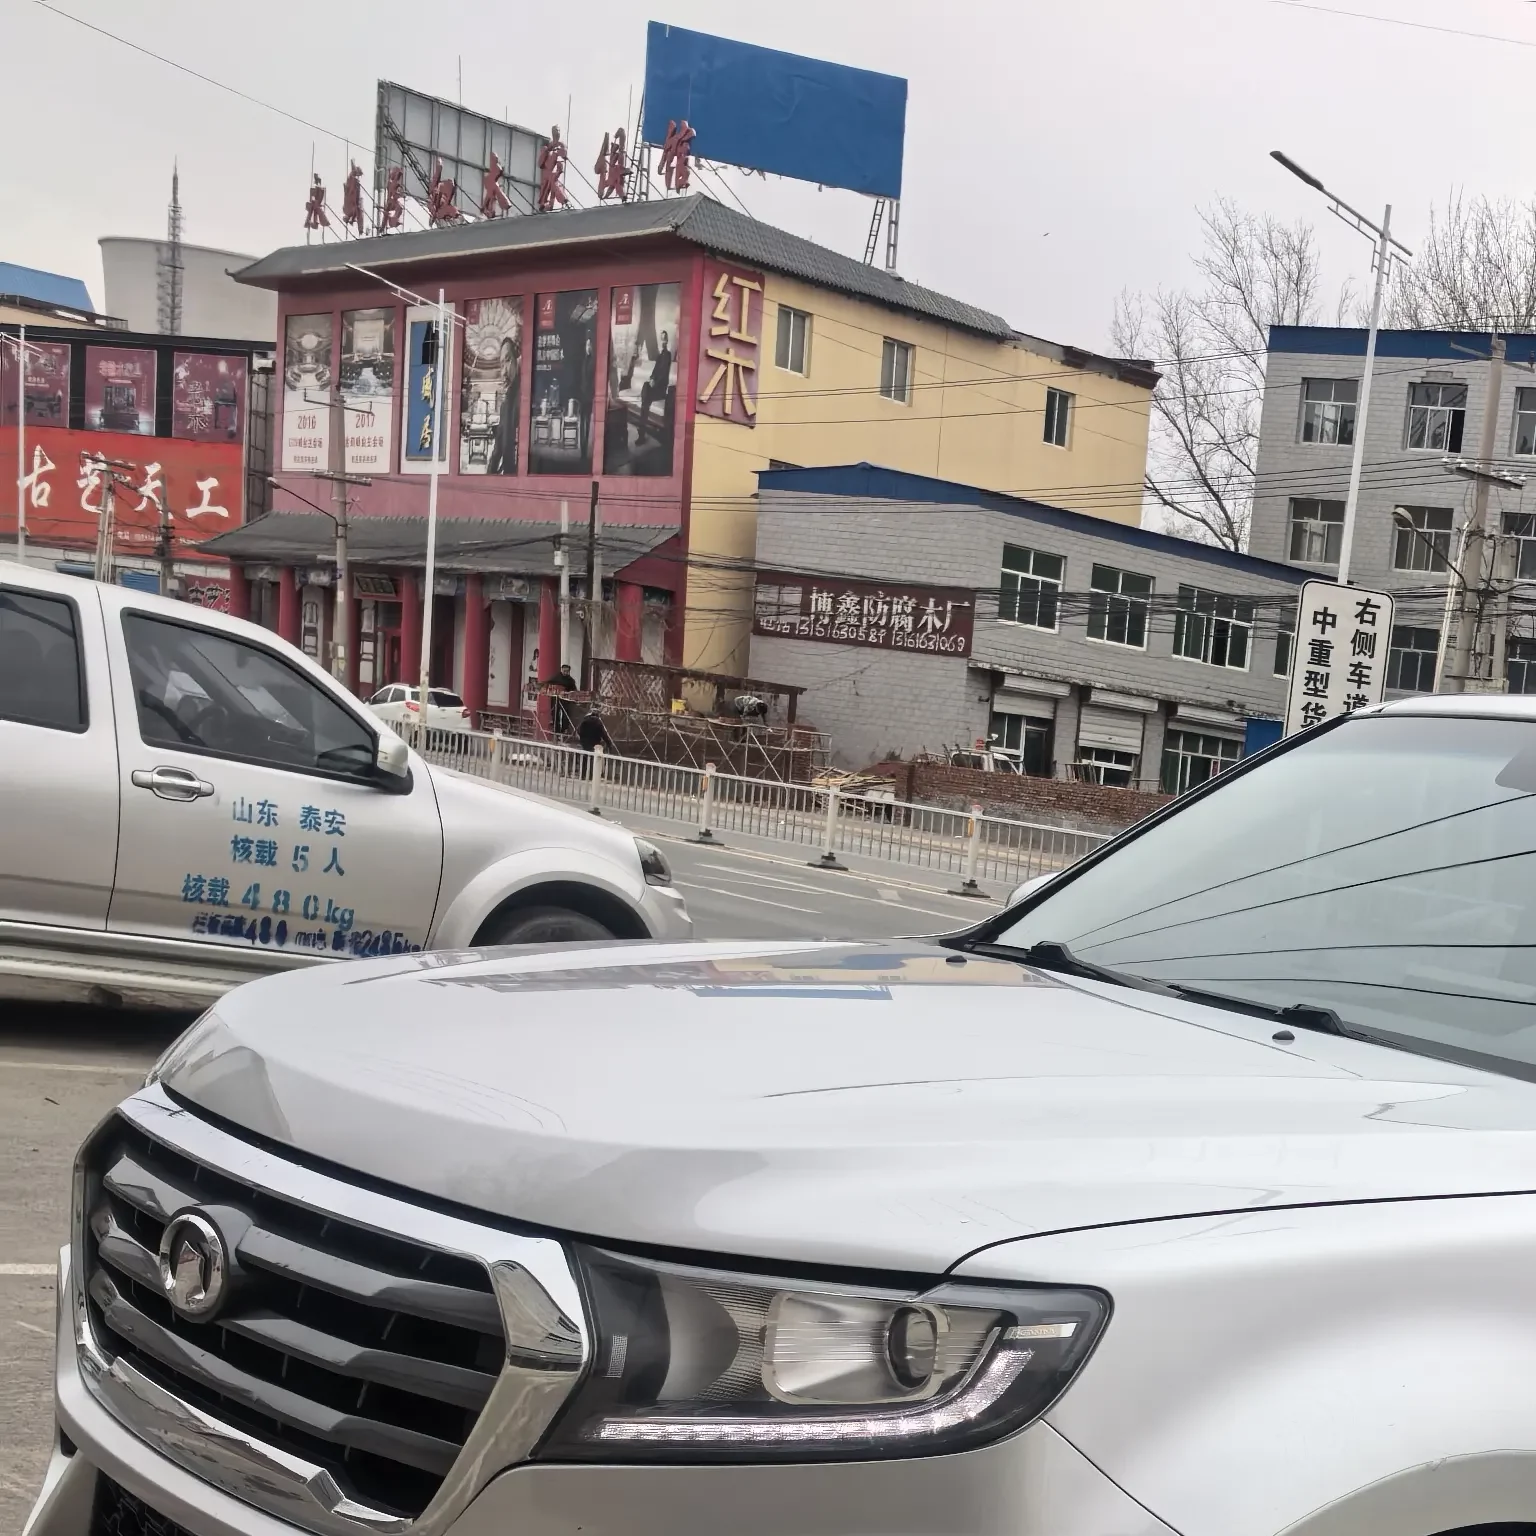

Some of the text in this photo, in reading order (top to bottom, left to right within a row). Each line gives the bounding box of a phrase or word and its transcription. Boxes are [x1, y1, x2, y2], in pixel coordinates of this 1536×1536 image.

[699, 272, 762, 418] 红木
[1300, 606, 1338, 729] 中重型货
[232, 796, 347, 837] 山东 泰安
[231, 834, 279, 867] 核载
[181, 873, 231, 907] 核载
